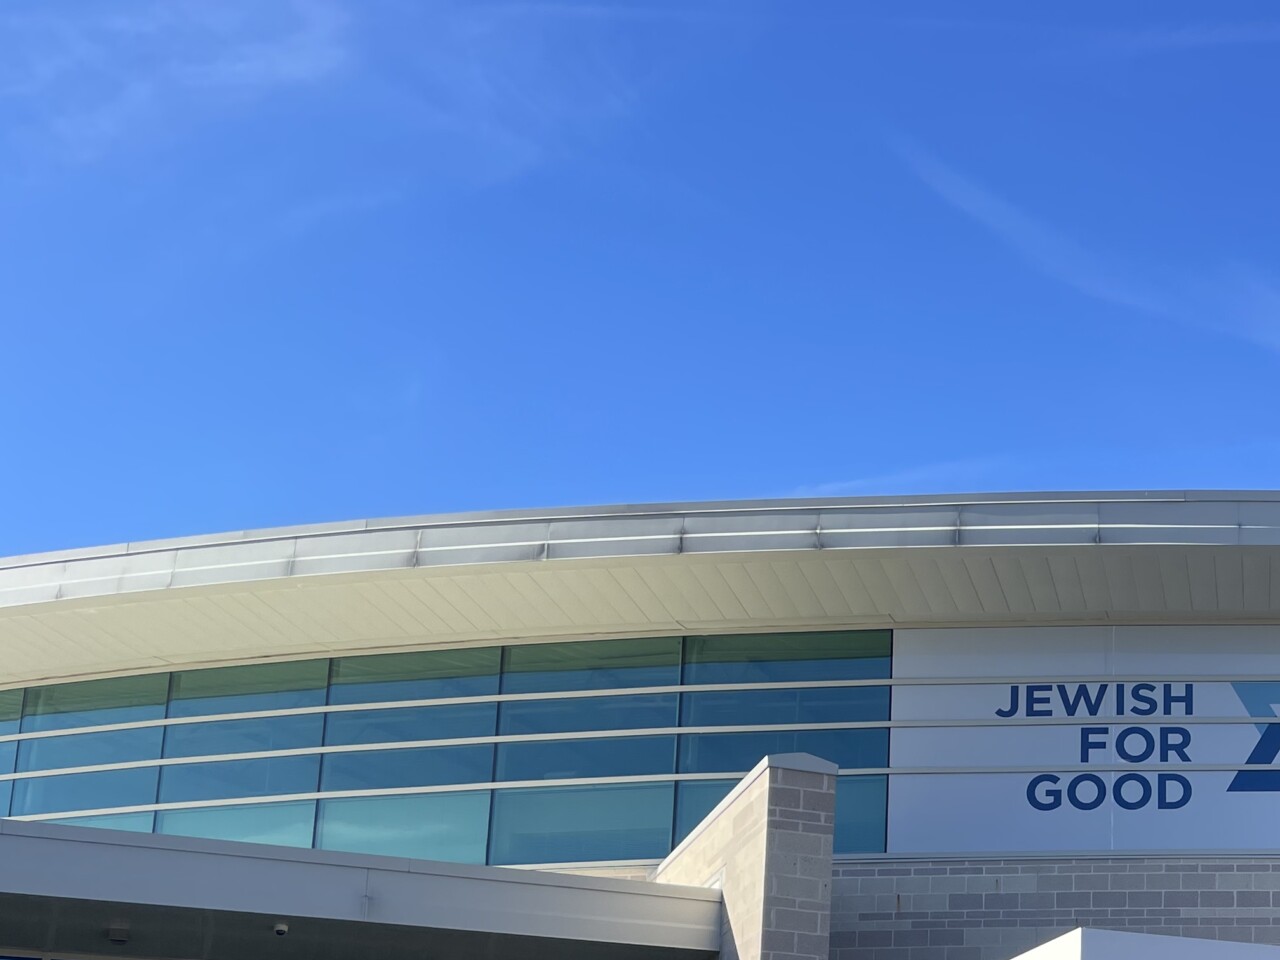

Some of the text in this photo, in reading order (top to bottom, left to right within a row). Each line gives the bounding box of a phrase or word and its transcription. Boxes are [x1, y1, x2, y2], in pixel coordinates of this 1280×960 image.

[995, 683, 1194, 718] JEWISH
[1080, 726, 1193, 764] FOR
[1026, 773, 1193, 811] GOOD
